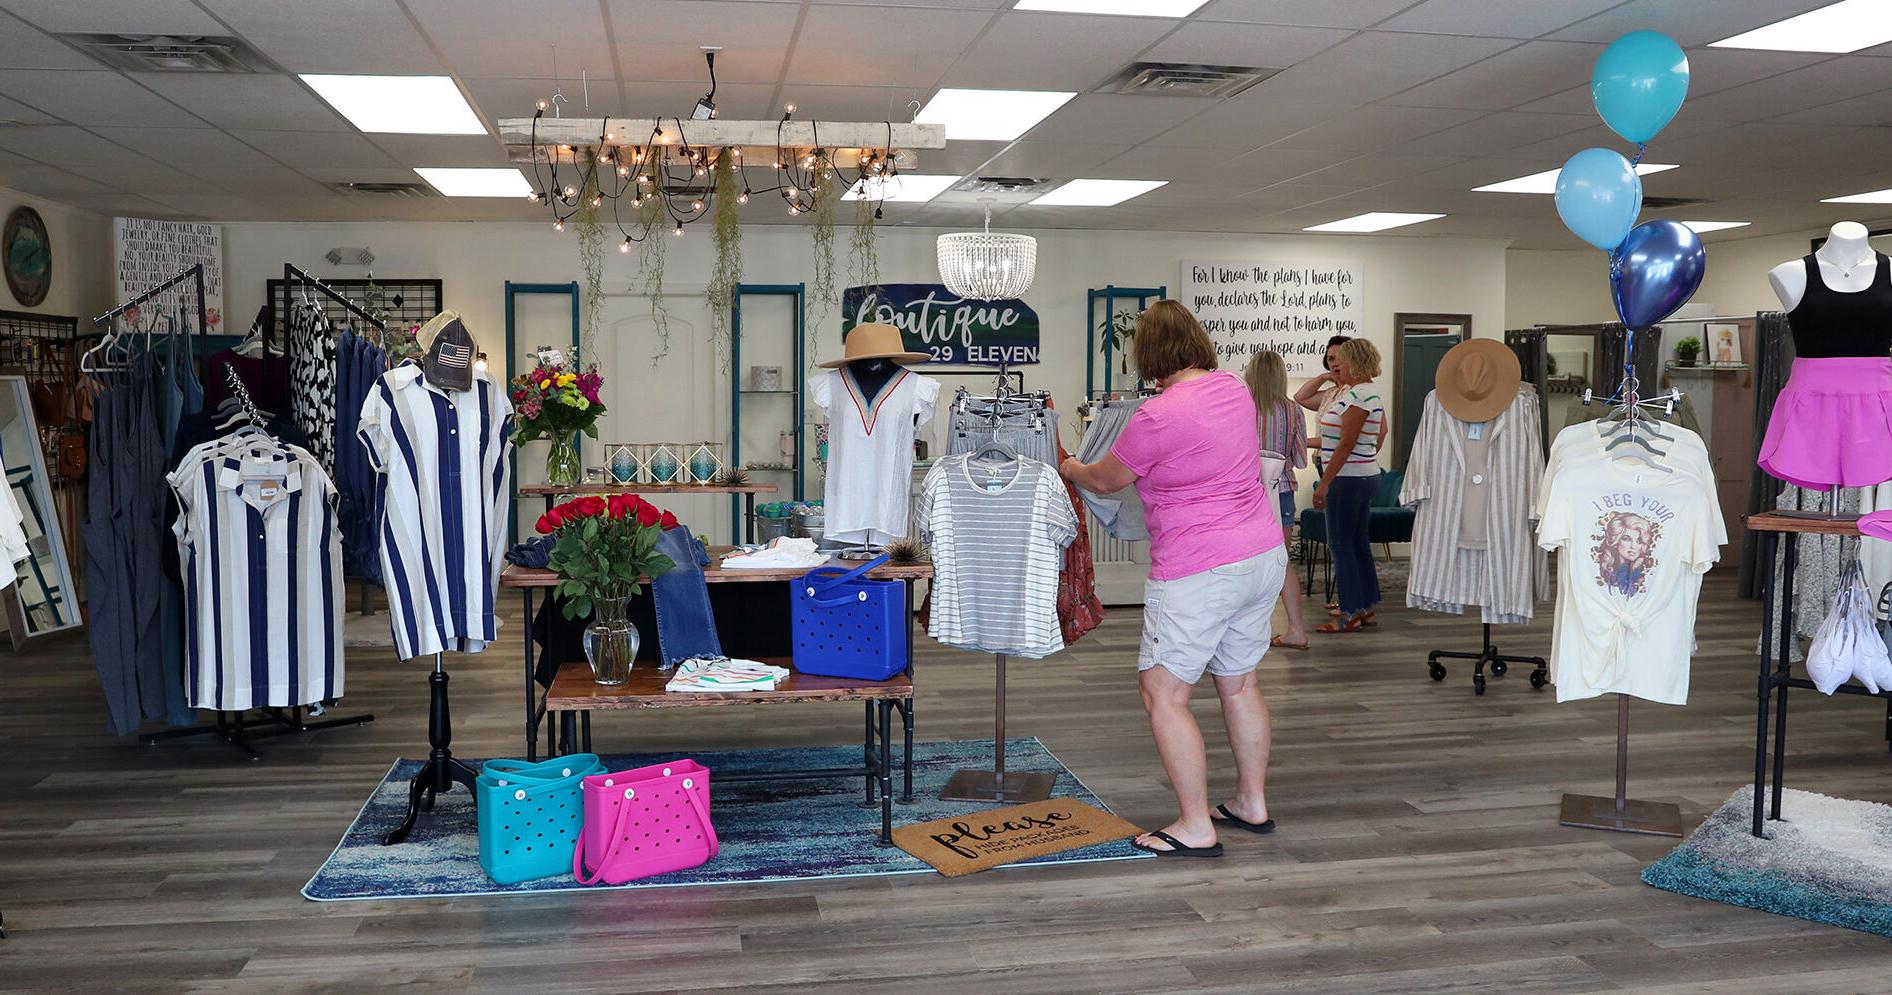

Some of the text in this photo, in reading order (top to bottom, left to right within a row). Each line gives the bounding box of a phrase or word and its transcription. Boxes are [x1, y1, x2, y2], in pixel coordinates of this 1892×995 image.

[143, 220, 156, 231] NOT
[158, 221, 177, 233] FANCY
[197, 224, 212, 235] GOLD
[125, 240, 150, 251] SHOULD
[150, 241, 167, 252] MAKE
[203, 235, 218, 246] THAT
[119, 260, 137, 271] FROM
[139, 261, 160, 272] INSIDE
[1192, 265, 1353, 291] For I know the plans I have for
[1194, 290, 1351, 314] you, declares the Lord, plans to
[1229, 318, 1248, 337] you
[1250, 316, 1270, 332] and
[1273, 316, 1291, 331] not
[1293, 316, 1304, 330] to
[1304, 315, 1334, 332] harm
[1336, 319, 1357, 336] you,
[929, 345, 1037, 362] 29 ELEVEN
[1214, 340, 1224, 355] to
[1225, 341, 1247, 362] give
[1270, 340, 1295, 359] hope
[1297, 340, 1317, 356] and
[1286, 363, 1304, 372] 9:11
[1592, 493, 1675, 523] I BEG YOUR
[930, 811, 1072, 859] please
[975, 824, 1080, 850] HIDE PACKAGES
[984, 842, 1025, 855] FROM
